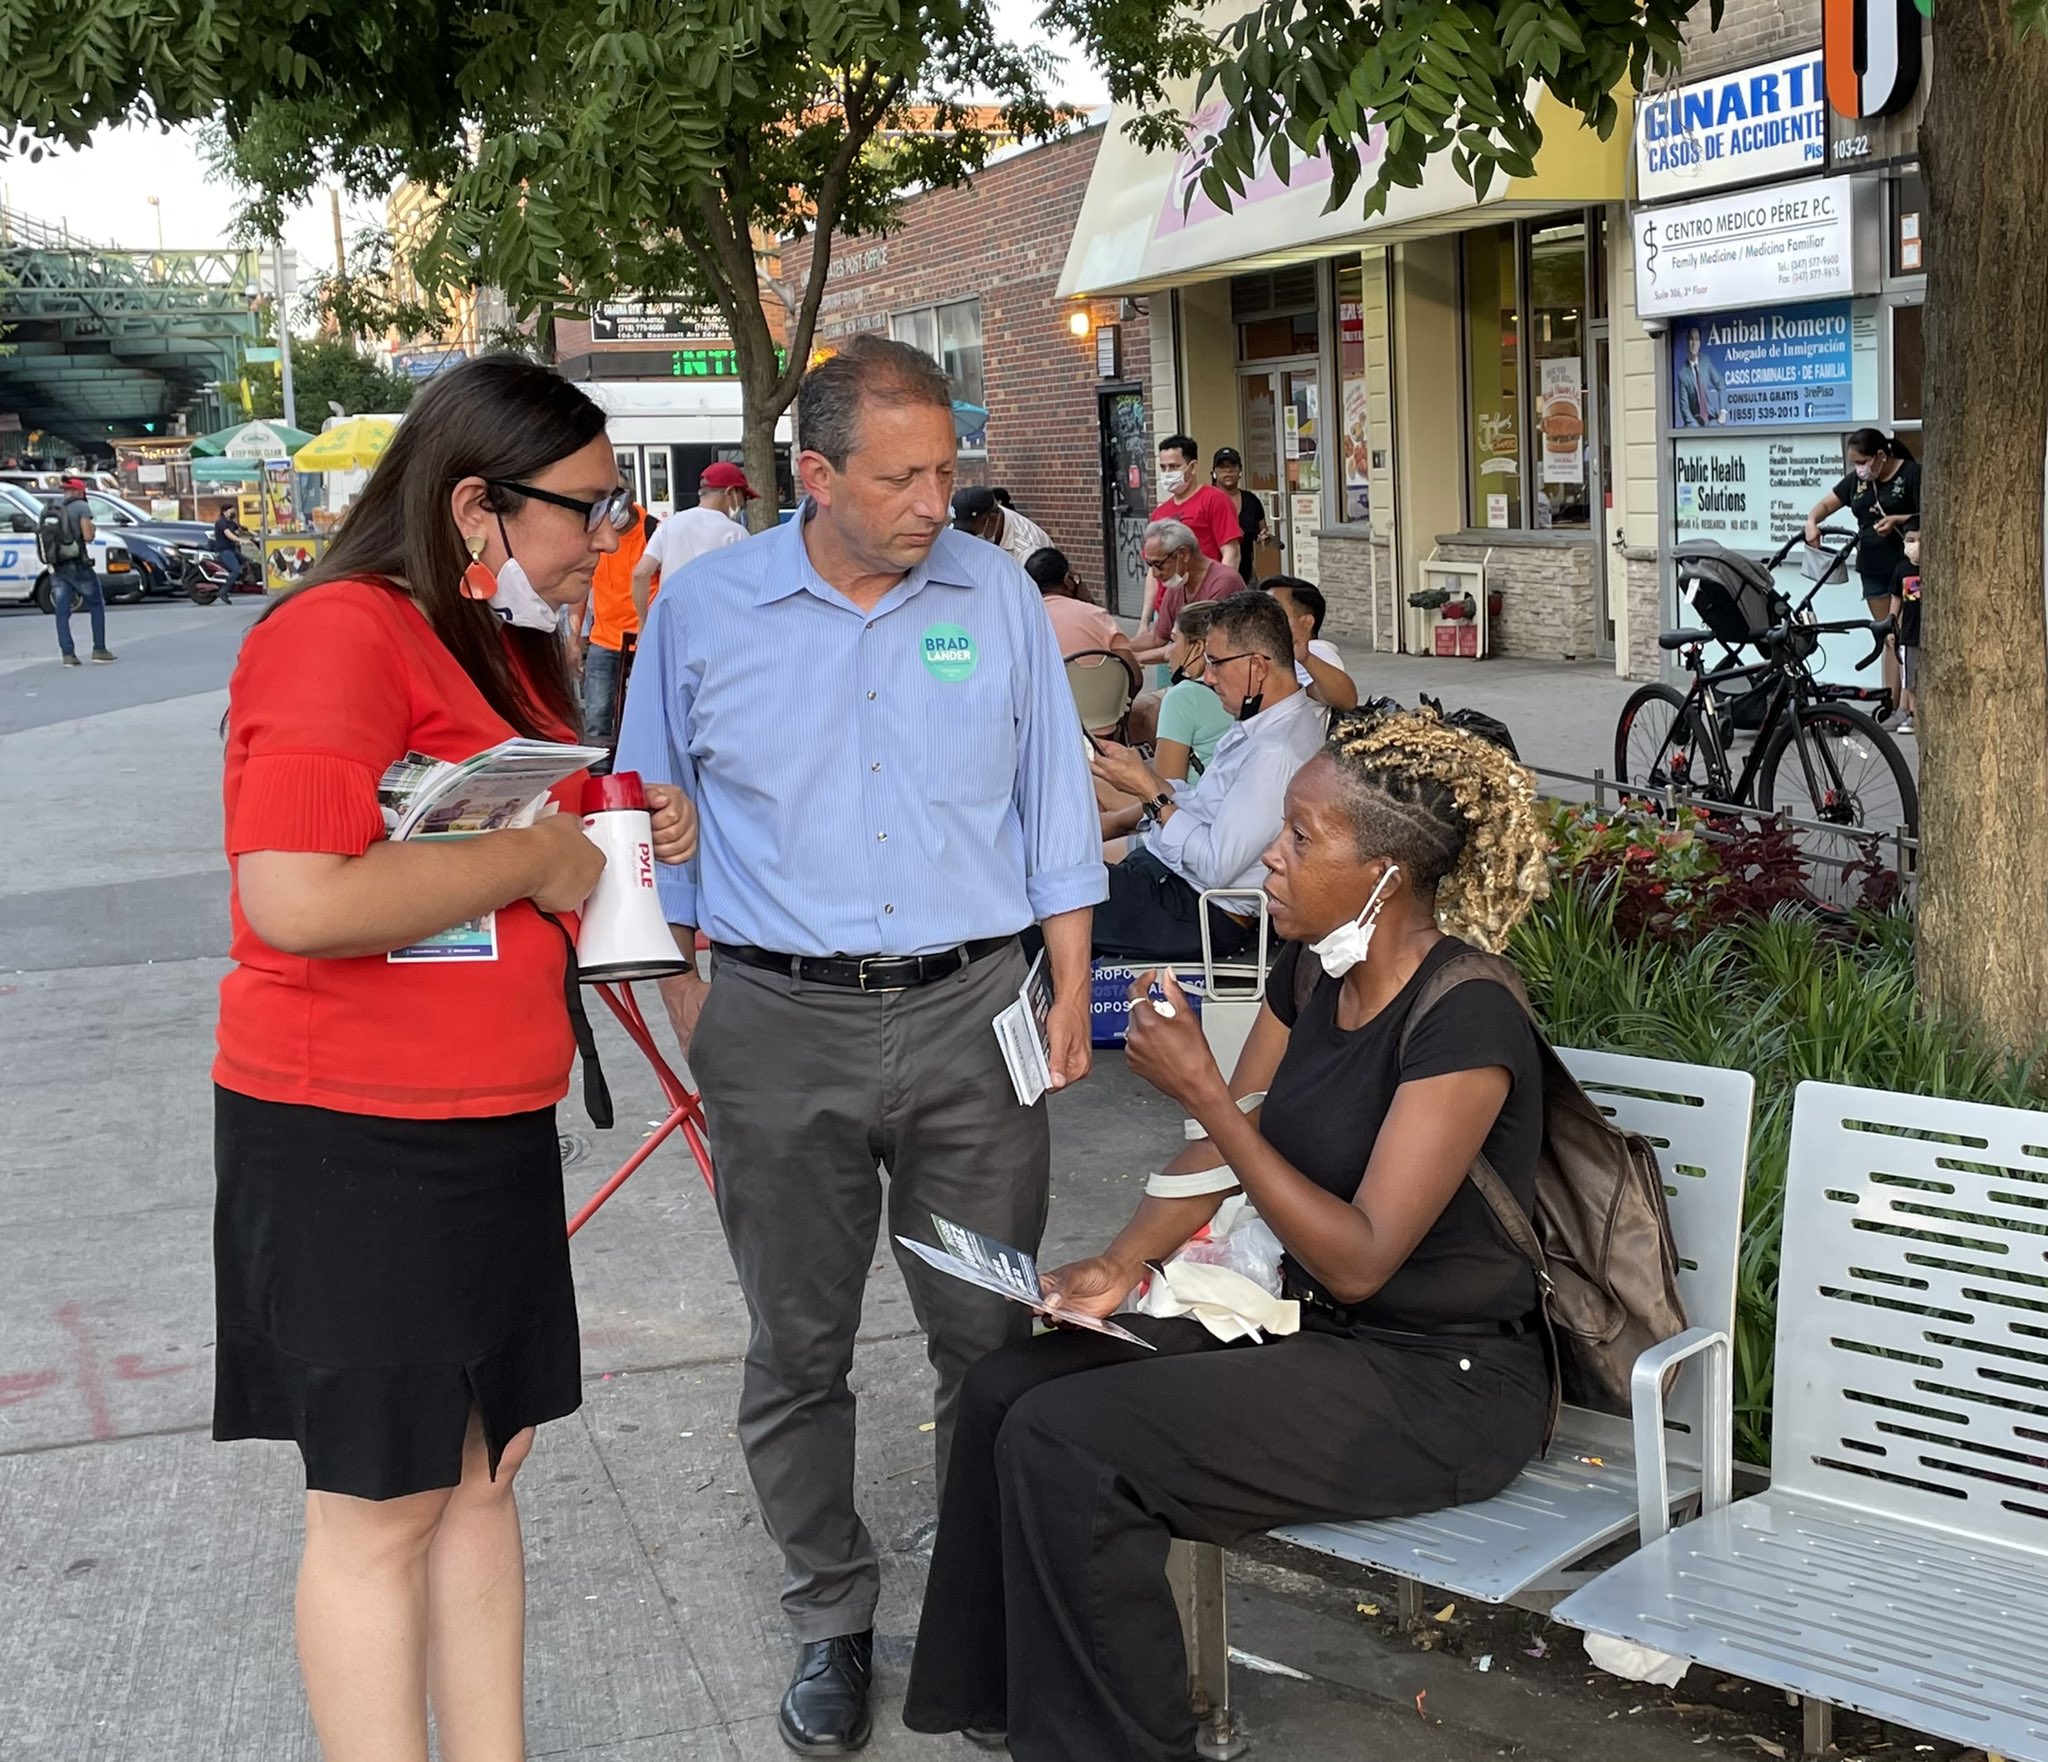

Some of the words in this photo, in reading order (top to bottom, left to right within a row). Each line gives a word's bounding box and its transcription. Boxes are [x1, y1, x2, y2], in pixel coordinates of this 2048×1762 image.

[1649, 139, 1700, 173] CASOS
[1705, 132, 1725, 161] DE
[1730, 110, 1823, 156] ACCIDENTE
[1833, 135, 1868, 159] 103-22
[1804, 143, 1823, 161] Pis
[1665, 218, 1713, 241] CENTRO
[1716, 208, 1767, 233] MEDICO
[1771, 198, 1808, 224] PÉREZ
[1813, 196, 1835, 217] P.C.
[846, 254, 862, 274] POST
[864, 246, 889, 270] OFFICE
[1672, 253, 1698, 270] Family
[1700, 248, 1737, 265] Medicine
[1745, 241, 1785, 258] Medicina
[1787, 235, 1825, 252] Familiar
[1654, 290, 1669, 300] Suite
[1693, 285, 1708, 295] Floor
[1707, 317, 1766, 346] Anibal
[1771, 315, 1846, 340] Romero
[1724, 345, 1767, 363] Abogado
[1769, 343, 1781, 357] de
[1783, 339, 1846, 358] Inmigración
[1724, 369, 1750, 386] CASOS
[1751, 366, 1797, 384] CRIMINALES
[1802, 364, 1813, 380] DE
[1814, 362, 1847, 378] FAMILIA
[1727, 392, 1768, 404] CONSULTA
[1769, 391, 1799, 402] GRATIS
[1728, 407, 1755, 421] 1(855)
[1758, 406, 1800, 419] 539-2013
[1778, 445, 1794, 454] Floor
[1677, 456, 1709, 483] Public
[1710, 455, 1746, 482] Health
[1769, 457, 1788, 465] Health
[1789, 456, 1819, 465] Insurance
[1769, 468, 1787, 476] Nurse
[1788, 467, 1808, 477] Family
[1698, 485, 1746, 512] Solutions
[1778, 501, 1794, 509] Floor
[1701, 519, 1726, 530] RESEARCH
[1770, 523, 1786, 532] Food
[925, 637, 969, 651] BRAD
[926, 650, 972, 661] LANDER
[638, 843, 653, 888] PYLE
